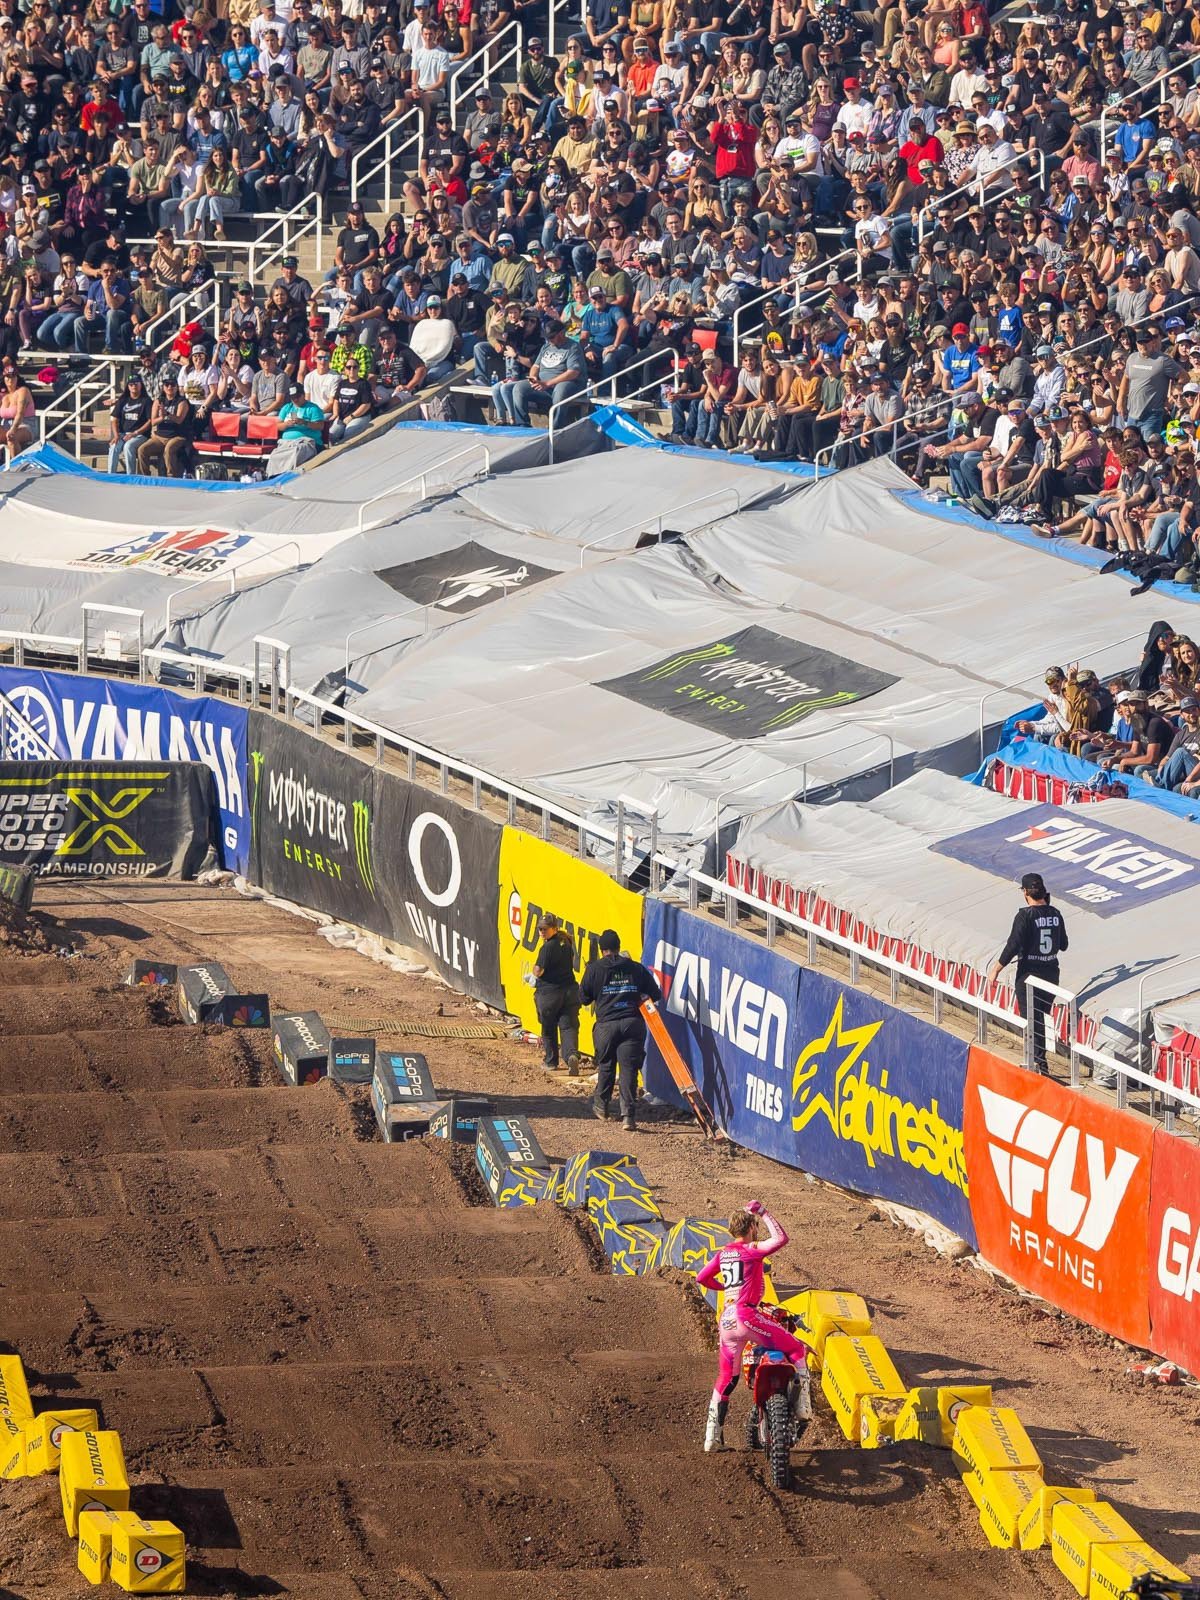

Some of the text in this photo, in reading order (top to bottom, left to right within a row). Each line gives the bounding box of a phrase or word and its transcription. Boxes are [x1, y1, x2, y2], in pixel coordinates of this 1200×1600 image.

[75, 553, 129, 564] 100
[153, 550, 226, 573] YEARS
[675, 684, 749, 713] ENERGY
[62, 698, 243, 818] YAMAHA
[0, 814, 63, 831] OTO
[31, 862, 157, 876] CHAMPIONSHIP
[284, 839, 342, 881] ENERGY
[1005, 817, 1194, 890] FALKEN
[405, 901, 477, 977] OAKLEY
[1035, 916, 1059, 928] VIDEO
[1039, 929, 1053, 954] 5
[189, 966, 226, 998] peacock
[653, 939, 788, 1070] FALKEN
[284, 1016, 324, 1051] peacock
[335, 1052, 370, 1060] GoPro
[404, 1057, 424, 1097] GoPro
[746, 1073, 783, 1122] TIRES
[507, 1119, 535, 1161] GoPro
[839, 1061, 970, 1199] alpinestars
[977, 1084, 1140, 1252] FLY
[720, 1261, 744, 1289] 51
[744, 1321, 772, 1337] GASGAS
[854, 1345, 885, 1391] DUNLOP
[827, 1367, 852, 1415] DUNLOP
[85, 1432, 104, 1477] DUNLOP
[990, 1414, 1021, 1465] DUNLOP
[985, 1504, 1011, 1542] DUNLOP
[1058, 1535, 1086, 1568] DUNLOP
